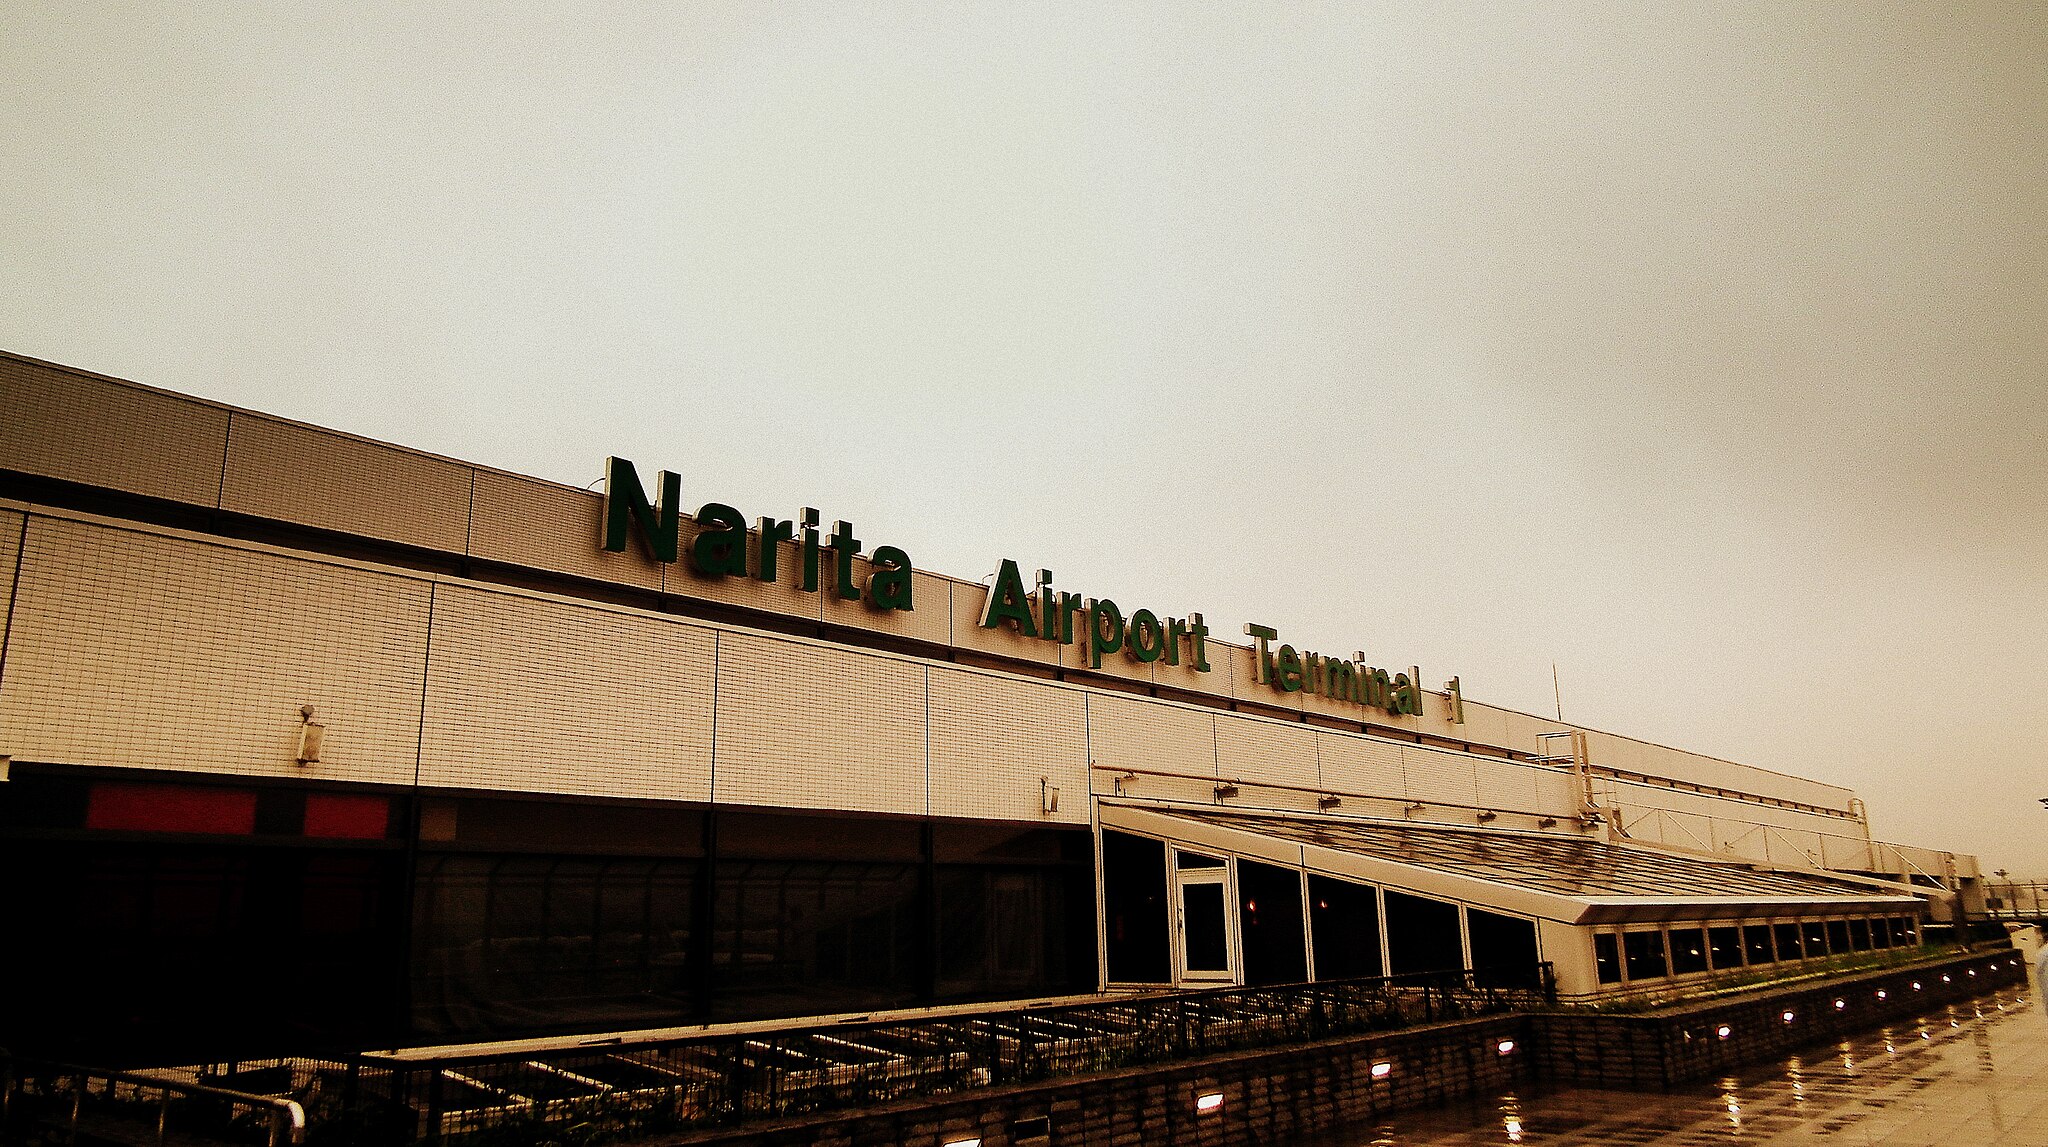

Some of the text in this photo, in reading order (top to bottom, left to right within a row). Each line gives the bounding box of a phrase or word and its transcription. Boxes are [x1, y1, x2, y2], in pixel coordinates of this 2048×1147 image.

[602, 455, 1464, 724] Narita Airport Terminal 1
